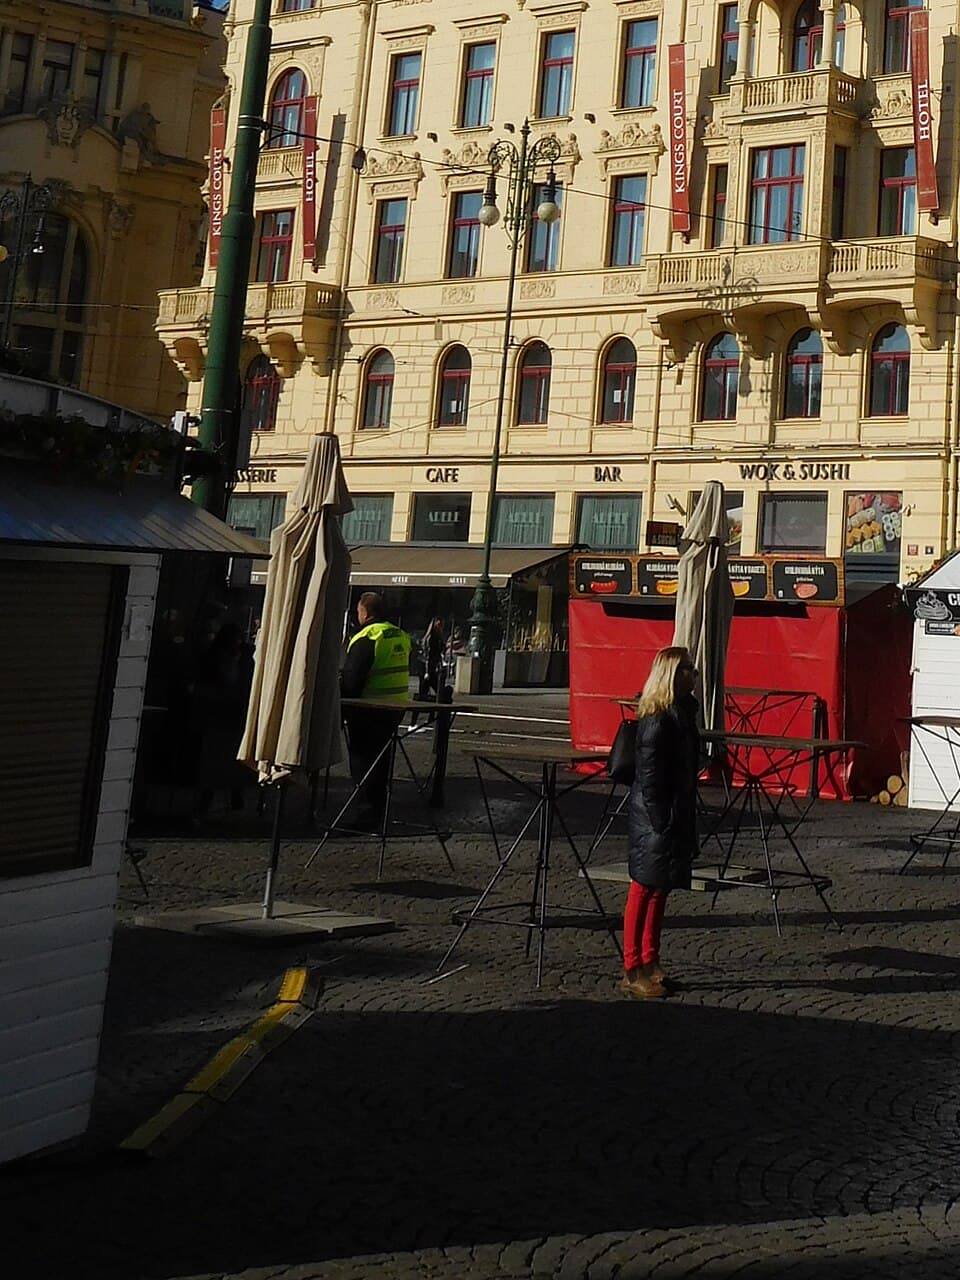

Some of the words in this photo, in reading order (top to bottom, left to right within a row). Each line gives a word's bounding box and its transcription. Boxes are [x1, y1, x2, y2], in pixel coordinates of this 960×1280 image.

[673, 89, 684, 140] COURT
[918, 80, 929, 140] HOTEL
[213, 147, 222, 190] COURT
[305, 152, 314, 202] HOTEL
[674, 143, 685, 193] KINGS
[212, 193, 222, 236] KINGS
[426, 468, 460, 483] CAFE
[593, 466, 623, 482] BAR
[739, 464, 781, 481] WOK
[782, 464, 796, 480] &
[799, 463, 850, 480] SUSHI
